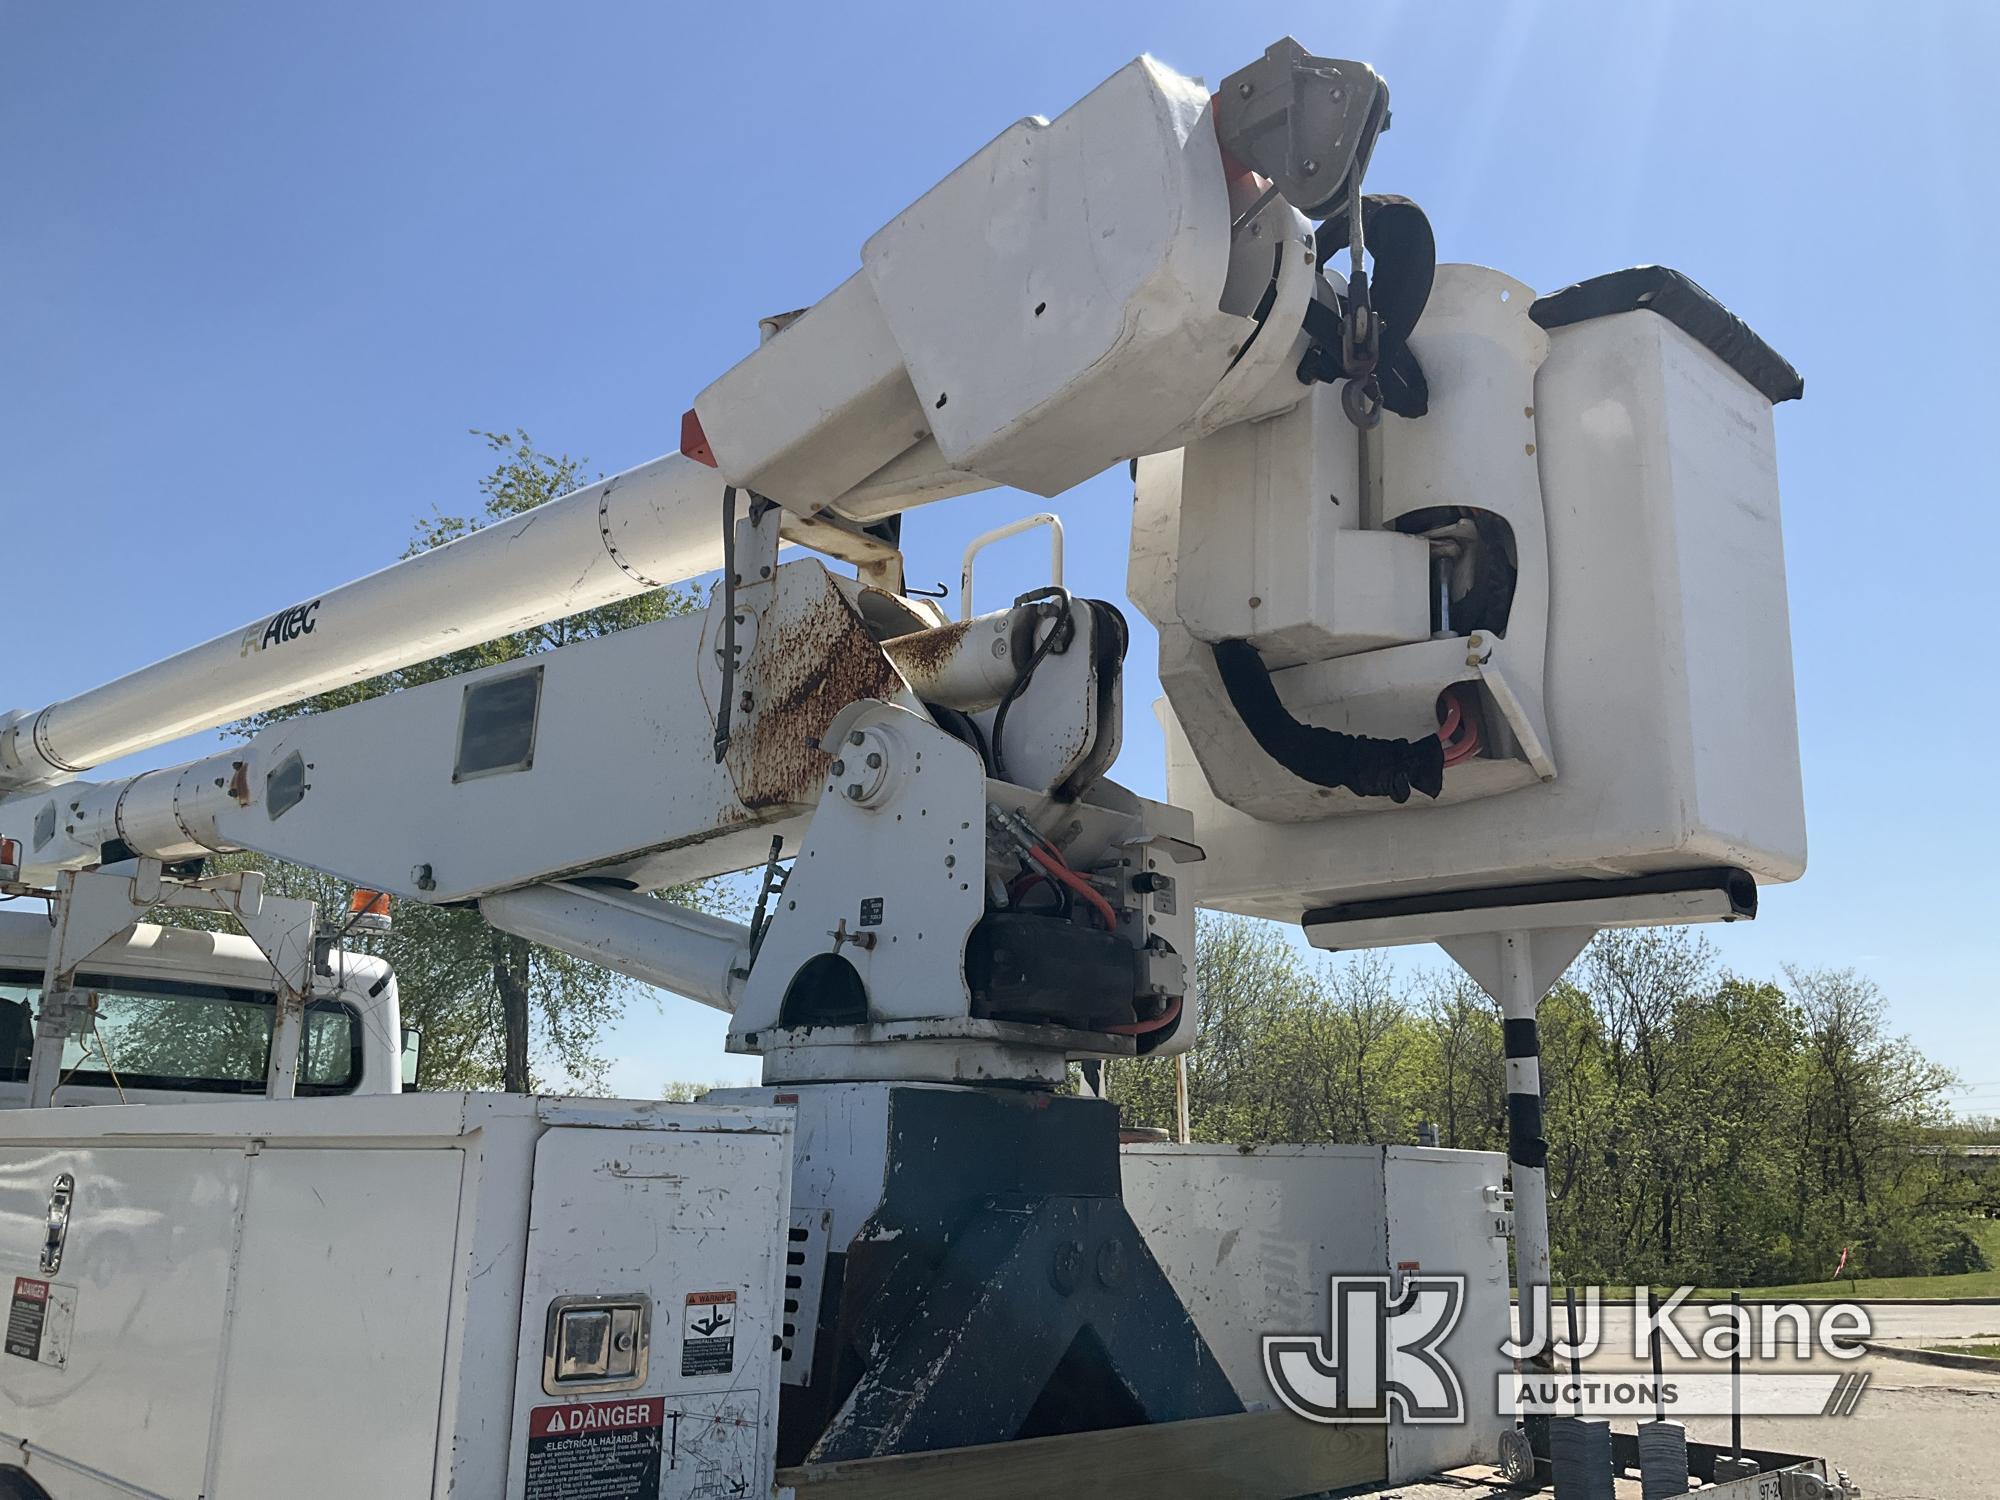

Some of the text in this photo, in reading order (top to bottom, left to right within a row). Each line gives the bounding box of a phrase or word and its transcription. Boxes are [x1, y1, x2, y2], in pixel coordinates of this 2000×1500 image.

[262, 600, 320, 650] Altec
[699, 1293, 732, 1304] WARNING
[570, 1404, 650, 1430] DANGER
[547, 1438, 598, 1451] ELECTRICAL
[600, 1432, 638, 1445] HAZARDS
